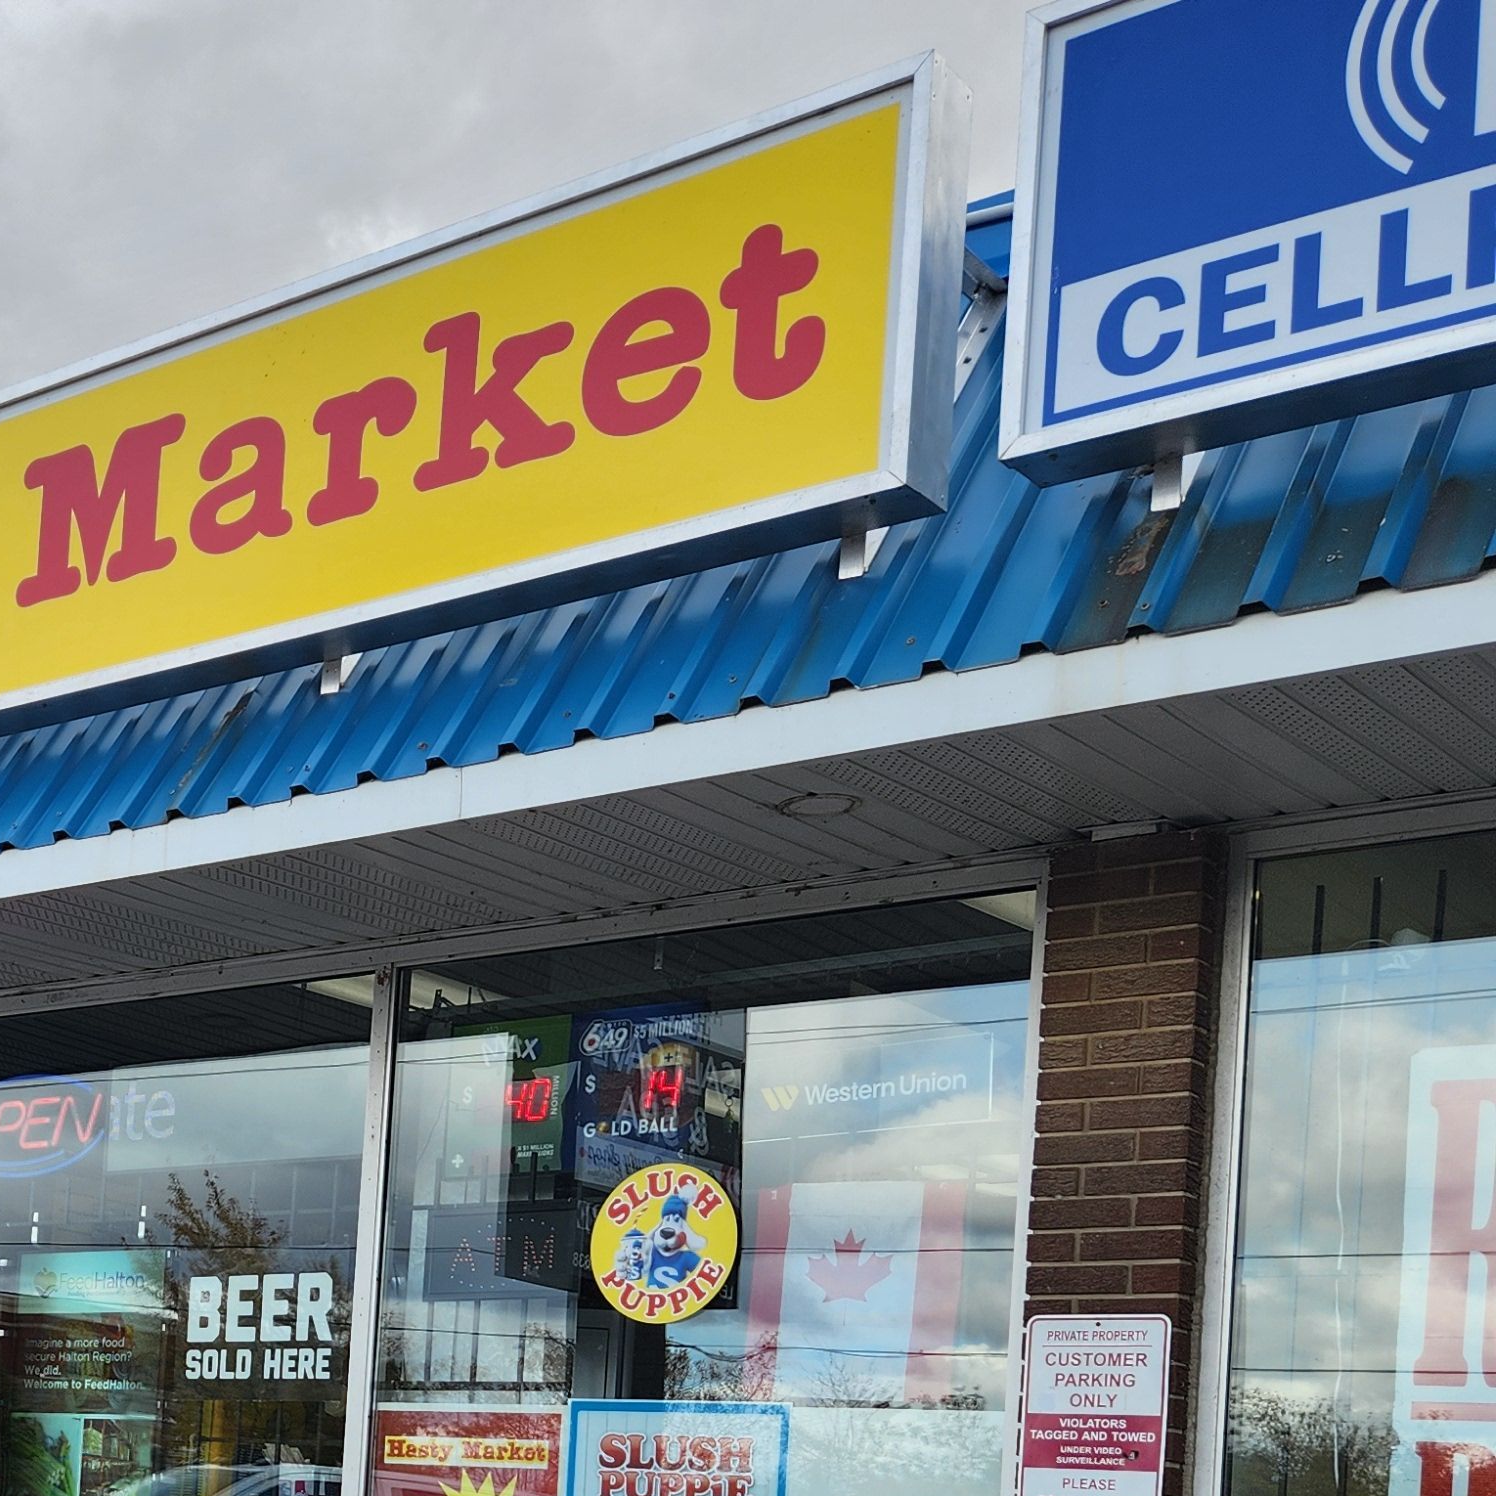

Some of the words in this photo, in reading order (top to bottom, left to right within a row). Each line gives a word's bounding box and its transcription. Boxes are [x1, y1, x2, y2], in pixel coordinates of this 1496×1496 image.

[15, 223, 827, 609] Market
[550, 1074, 561, 1117] MILLION
[585, 1074, 597, 1095] $
[644, 1067, 682, 1110] 14
[804, 1080, 895, 1106] Western
[899, 1071, 967, 1096] Union
[505, 1076, 552, 1122] 40
[638, 1117, 678, 1136] BALL
[606, 1168, 724, 1228] SLUSH
[449, 1233, 555, 1278] ATM
[58, 1271, 145, 1290] FeedHalton
[600, 1258, 726, 1318] PUPPIE
[186, 1271, 334, 1343] BEER
[25, 1338, 63, 1351] Imagine
[65, 1340, 72, 1348] a
[73, 1340, 99, 1348] more
[102, 1337, 125, 1348] food
[1047, 1330, 1089, 1341] PRIVATE
[1092, 1329, 1148, 1341] PROPERTY
[25, 1353, 56, 1362] secure
[58, 1352, 90, 1362] Halton
[92, 1351, 133, 1364] Region?
[185, 1348, 252, 1380] SOLD
[263, 1347, 333, 1380] HERE
[1045, 1352, 1148, 1367] CUSTOMER
[24, 1365, 41, 1376] We
[43, 1366, 62, 1376] did.
[23, 1379, 69, 1390] Welcome
[71, 1380, 82, 1390] to
[1054, 1373, 1136, 1388] PARKING
[1069, 1393, 1118, 1408] ONLY
[1059, 1418, 1127, 1429] VIOLATORS
[1030, 1429, 1078, 1441] TAGGED
[1081, 1430, 1108, 1441] AND
[1112, 1431, 1156, 1443] TOWED
[386, 1438, 453, 1462] Hasty
[461, 1440, 546, 1462] Market
[598, 1432, 755, 1473] SLUSH
[1060, 1445, 1092, 1455] UNDER
[1093, 1446, 1122, 1456] VIDEO
[1055, 1456, 1126, 1466] SURVEILLANCE
[1062, 1478, 1116, 1491] PLEASE
